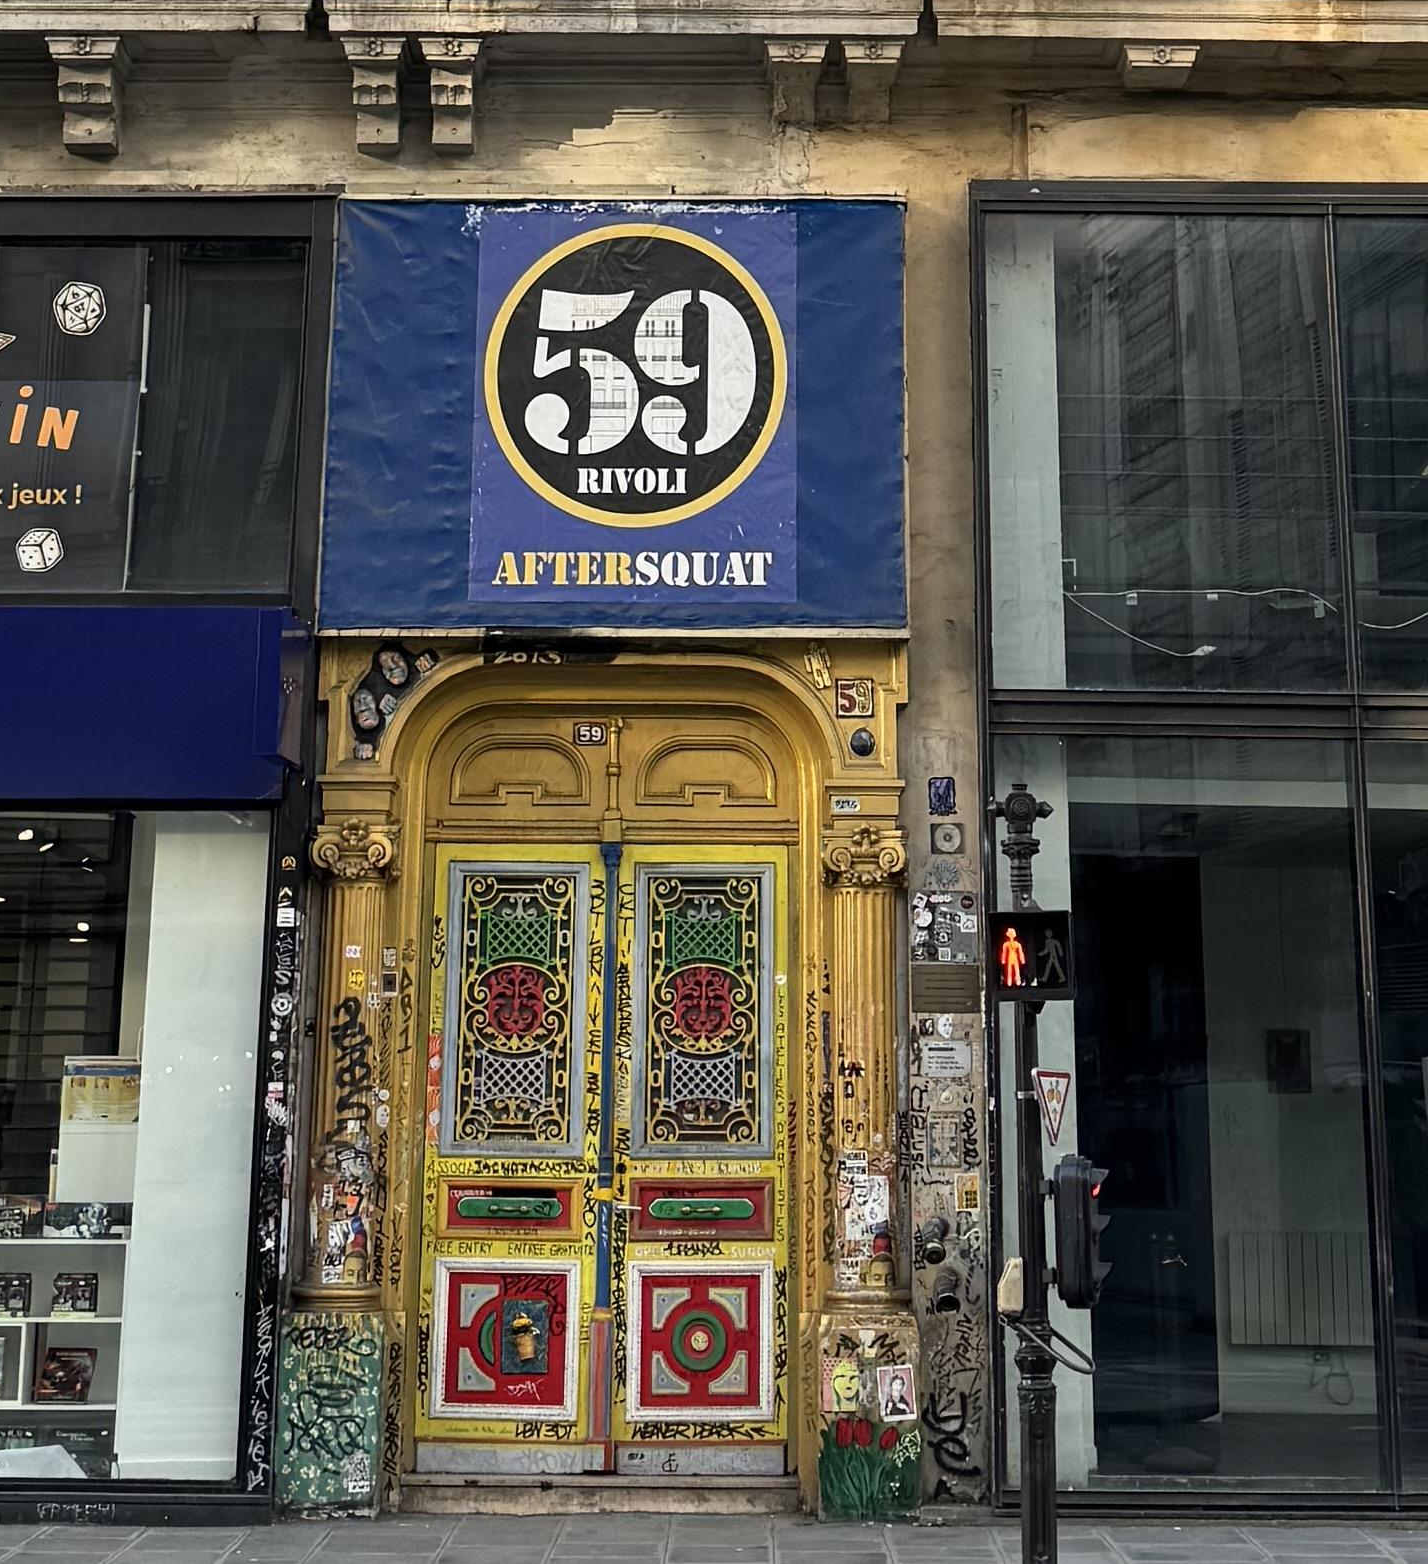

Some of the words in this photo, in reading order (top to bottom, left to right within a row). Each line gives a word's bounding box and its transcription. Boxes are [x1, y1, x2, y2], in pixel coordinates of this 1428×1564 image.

[524, 289, 757, 455] 59
[577, 468, 687, 494] RIVOLI
[8, 482, 68, 509] jeux
[491, 551, 772, 586] AFTERSQUAT
[839, 680, 871, 714] 59
[579, 726, 602, 742] 59
[426, 1241, 453, 1254] FREE
[458, 1241, 493, 1256] ENTRY
